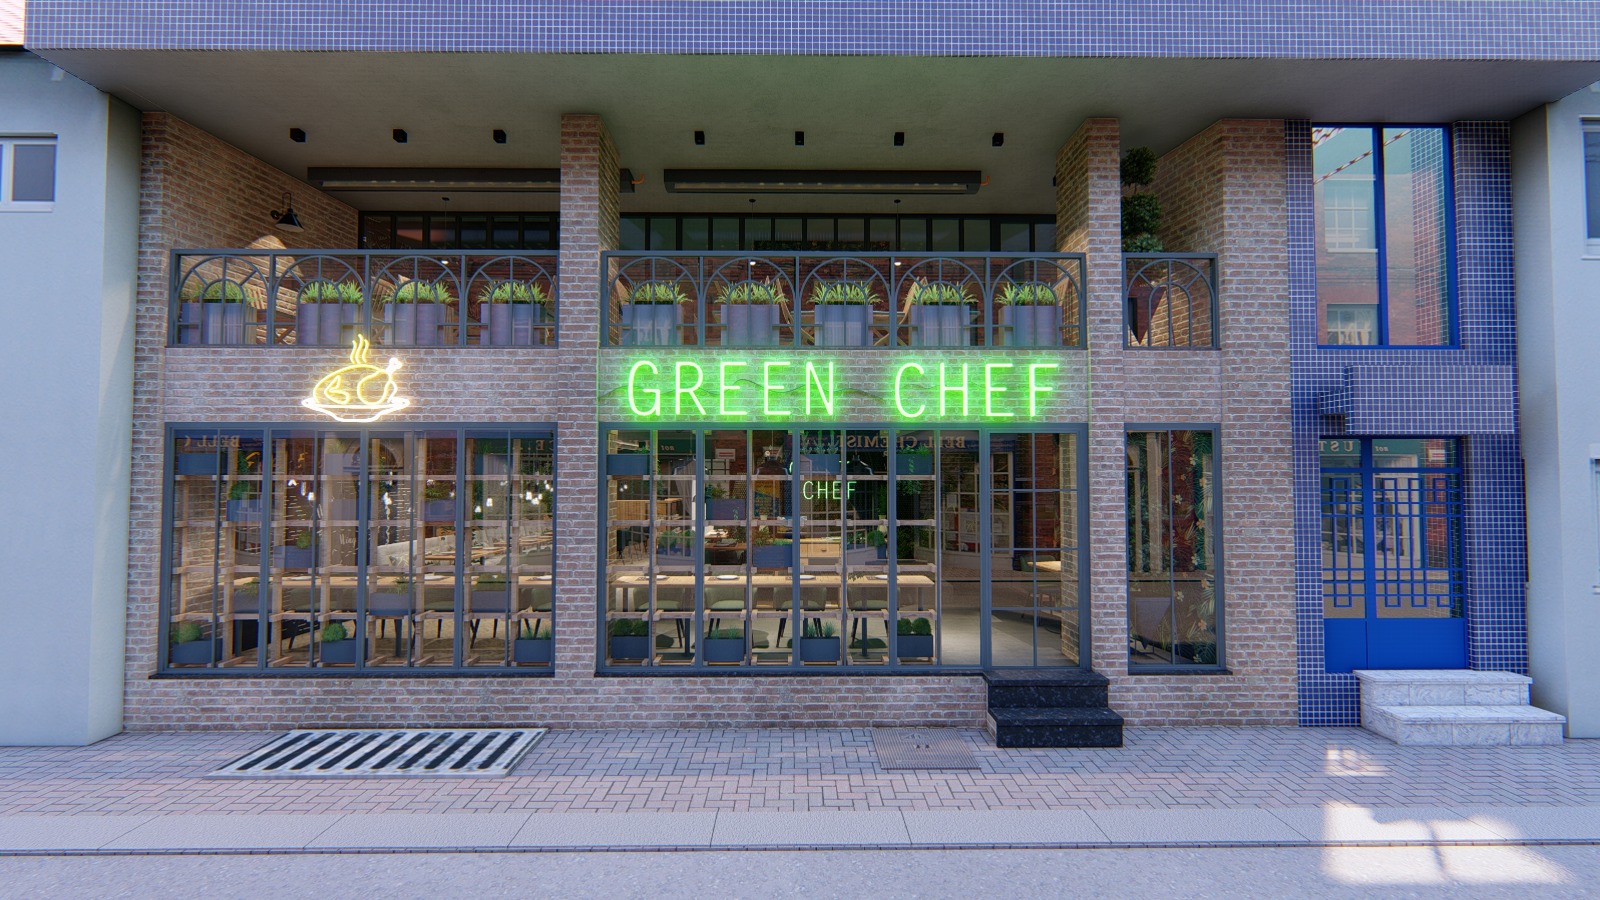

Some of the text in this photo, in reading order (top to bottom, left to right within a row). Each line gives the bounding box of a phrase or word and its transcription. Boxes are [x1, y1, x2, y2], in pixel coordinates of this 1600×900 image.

[627, 360, 1060, 417] GREEN CHEF
[802, 480, 857, 500] CHEF
